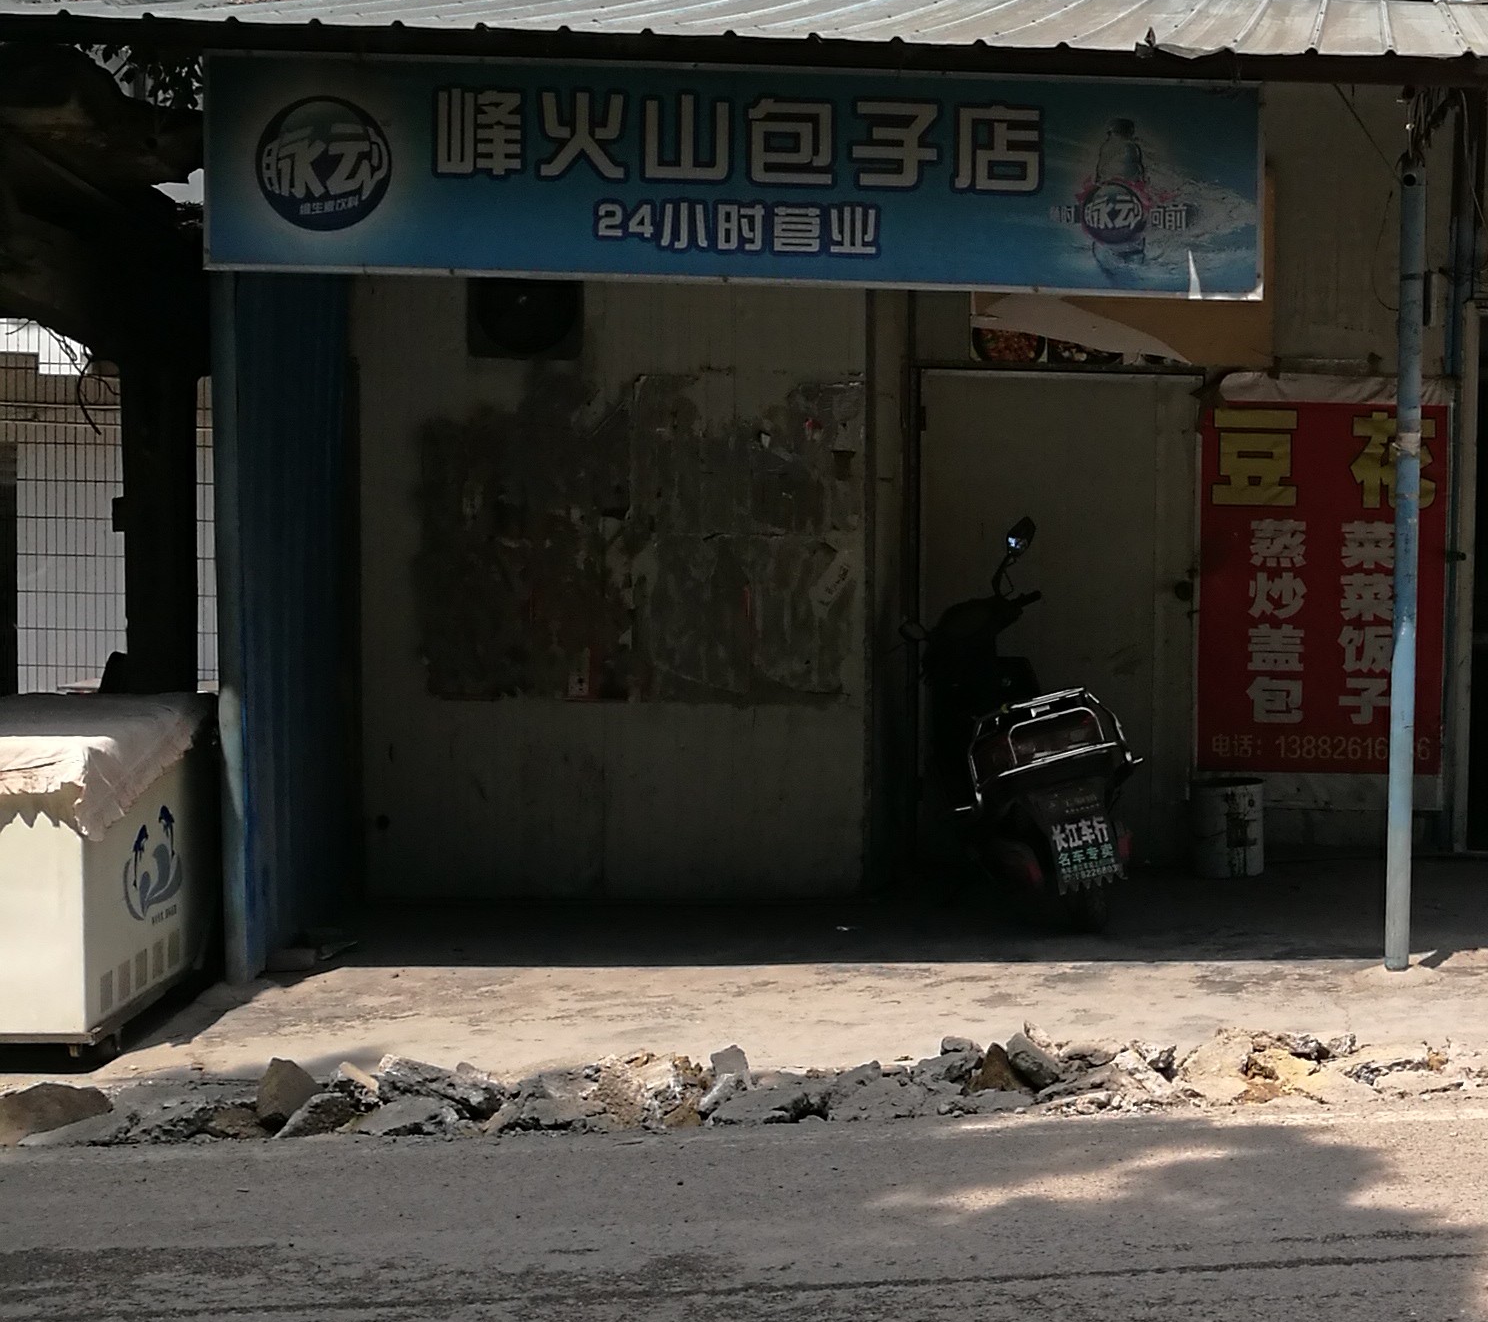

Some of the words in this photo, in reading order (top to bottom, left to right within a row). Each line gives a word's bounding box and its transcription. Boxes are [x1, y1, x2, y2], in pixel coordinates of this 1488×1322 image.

[262, 123, 388, 201] 脉动
[437, 87, 1040, 191] 峰火山包子店
[598, 201, 876, 254] 24小时营业
